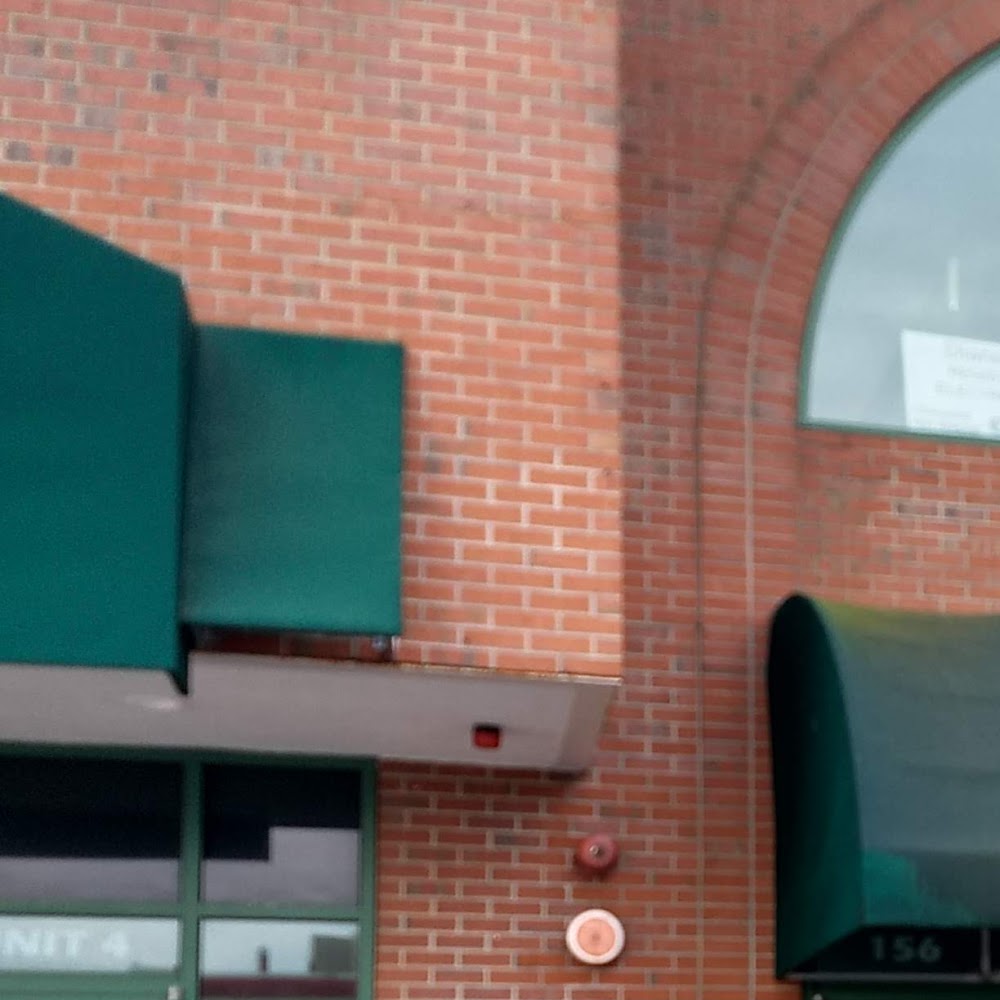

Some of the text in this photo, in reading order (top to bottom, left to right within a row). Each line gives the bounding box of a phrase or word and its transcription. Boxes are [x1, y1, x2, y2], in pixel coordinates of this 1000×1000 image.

[0, 928, 129, 957] NIT 4
[871, 934, 942, 963] 156
